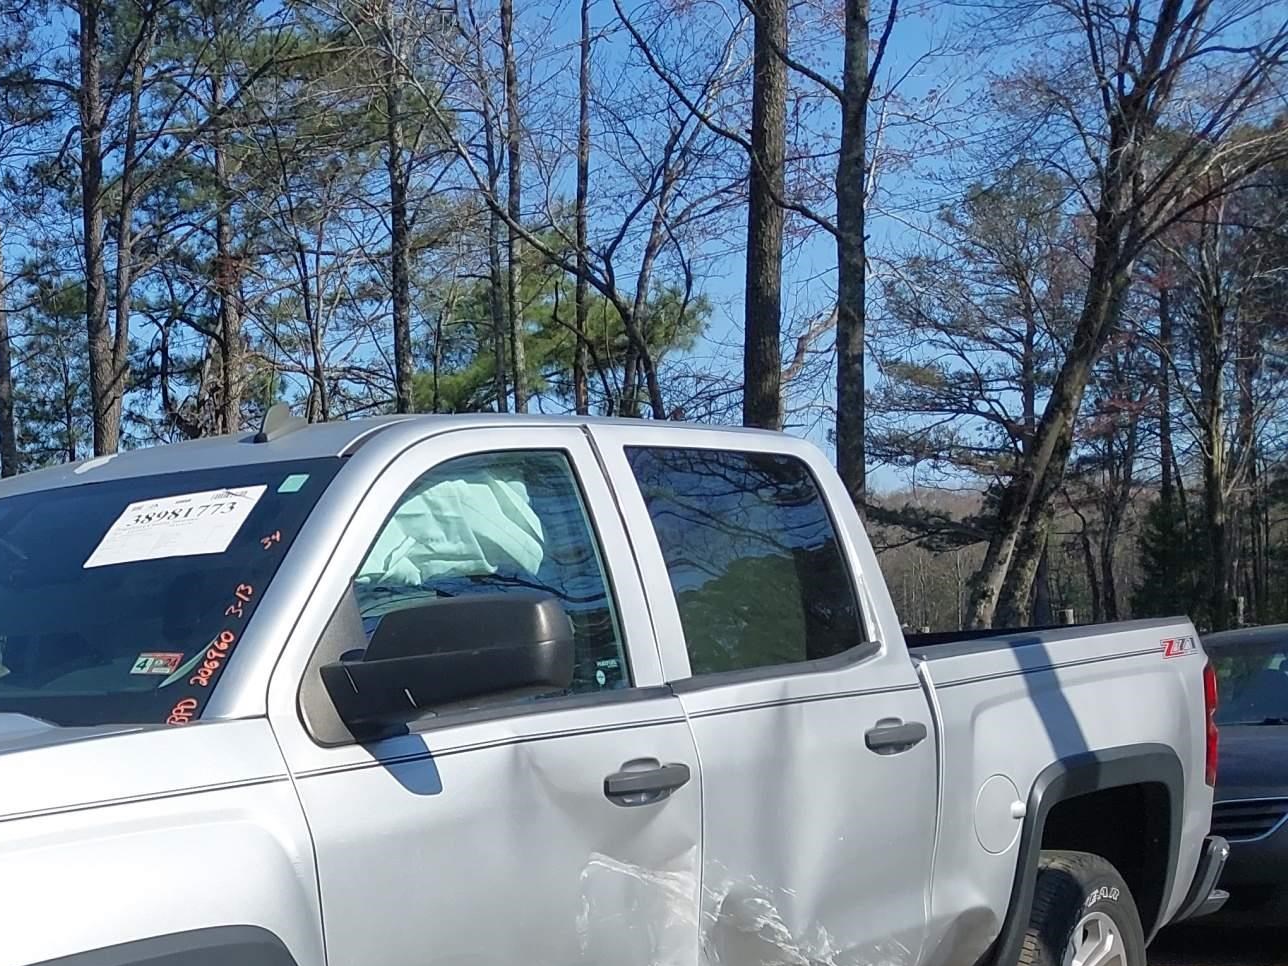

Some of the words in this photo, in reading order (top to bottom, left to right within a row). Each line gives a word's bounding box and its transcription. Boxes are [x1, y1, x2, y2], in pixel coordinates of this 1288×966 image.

[127, 502, 237, 526] 38981773
[225, 584, 253, 618] 3-13
[136, 659, 149, 670] 4
